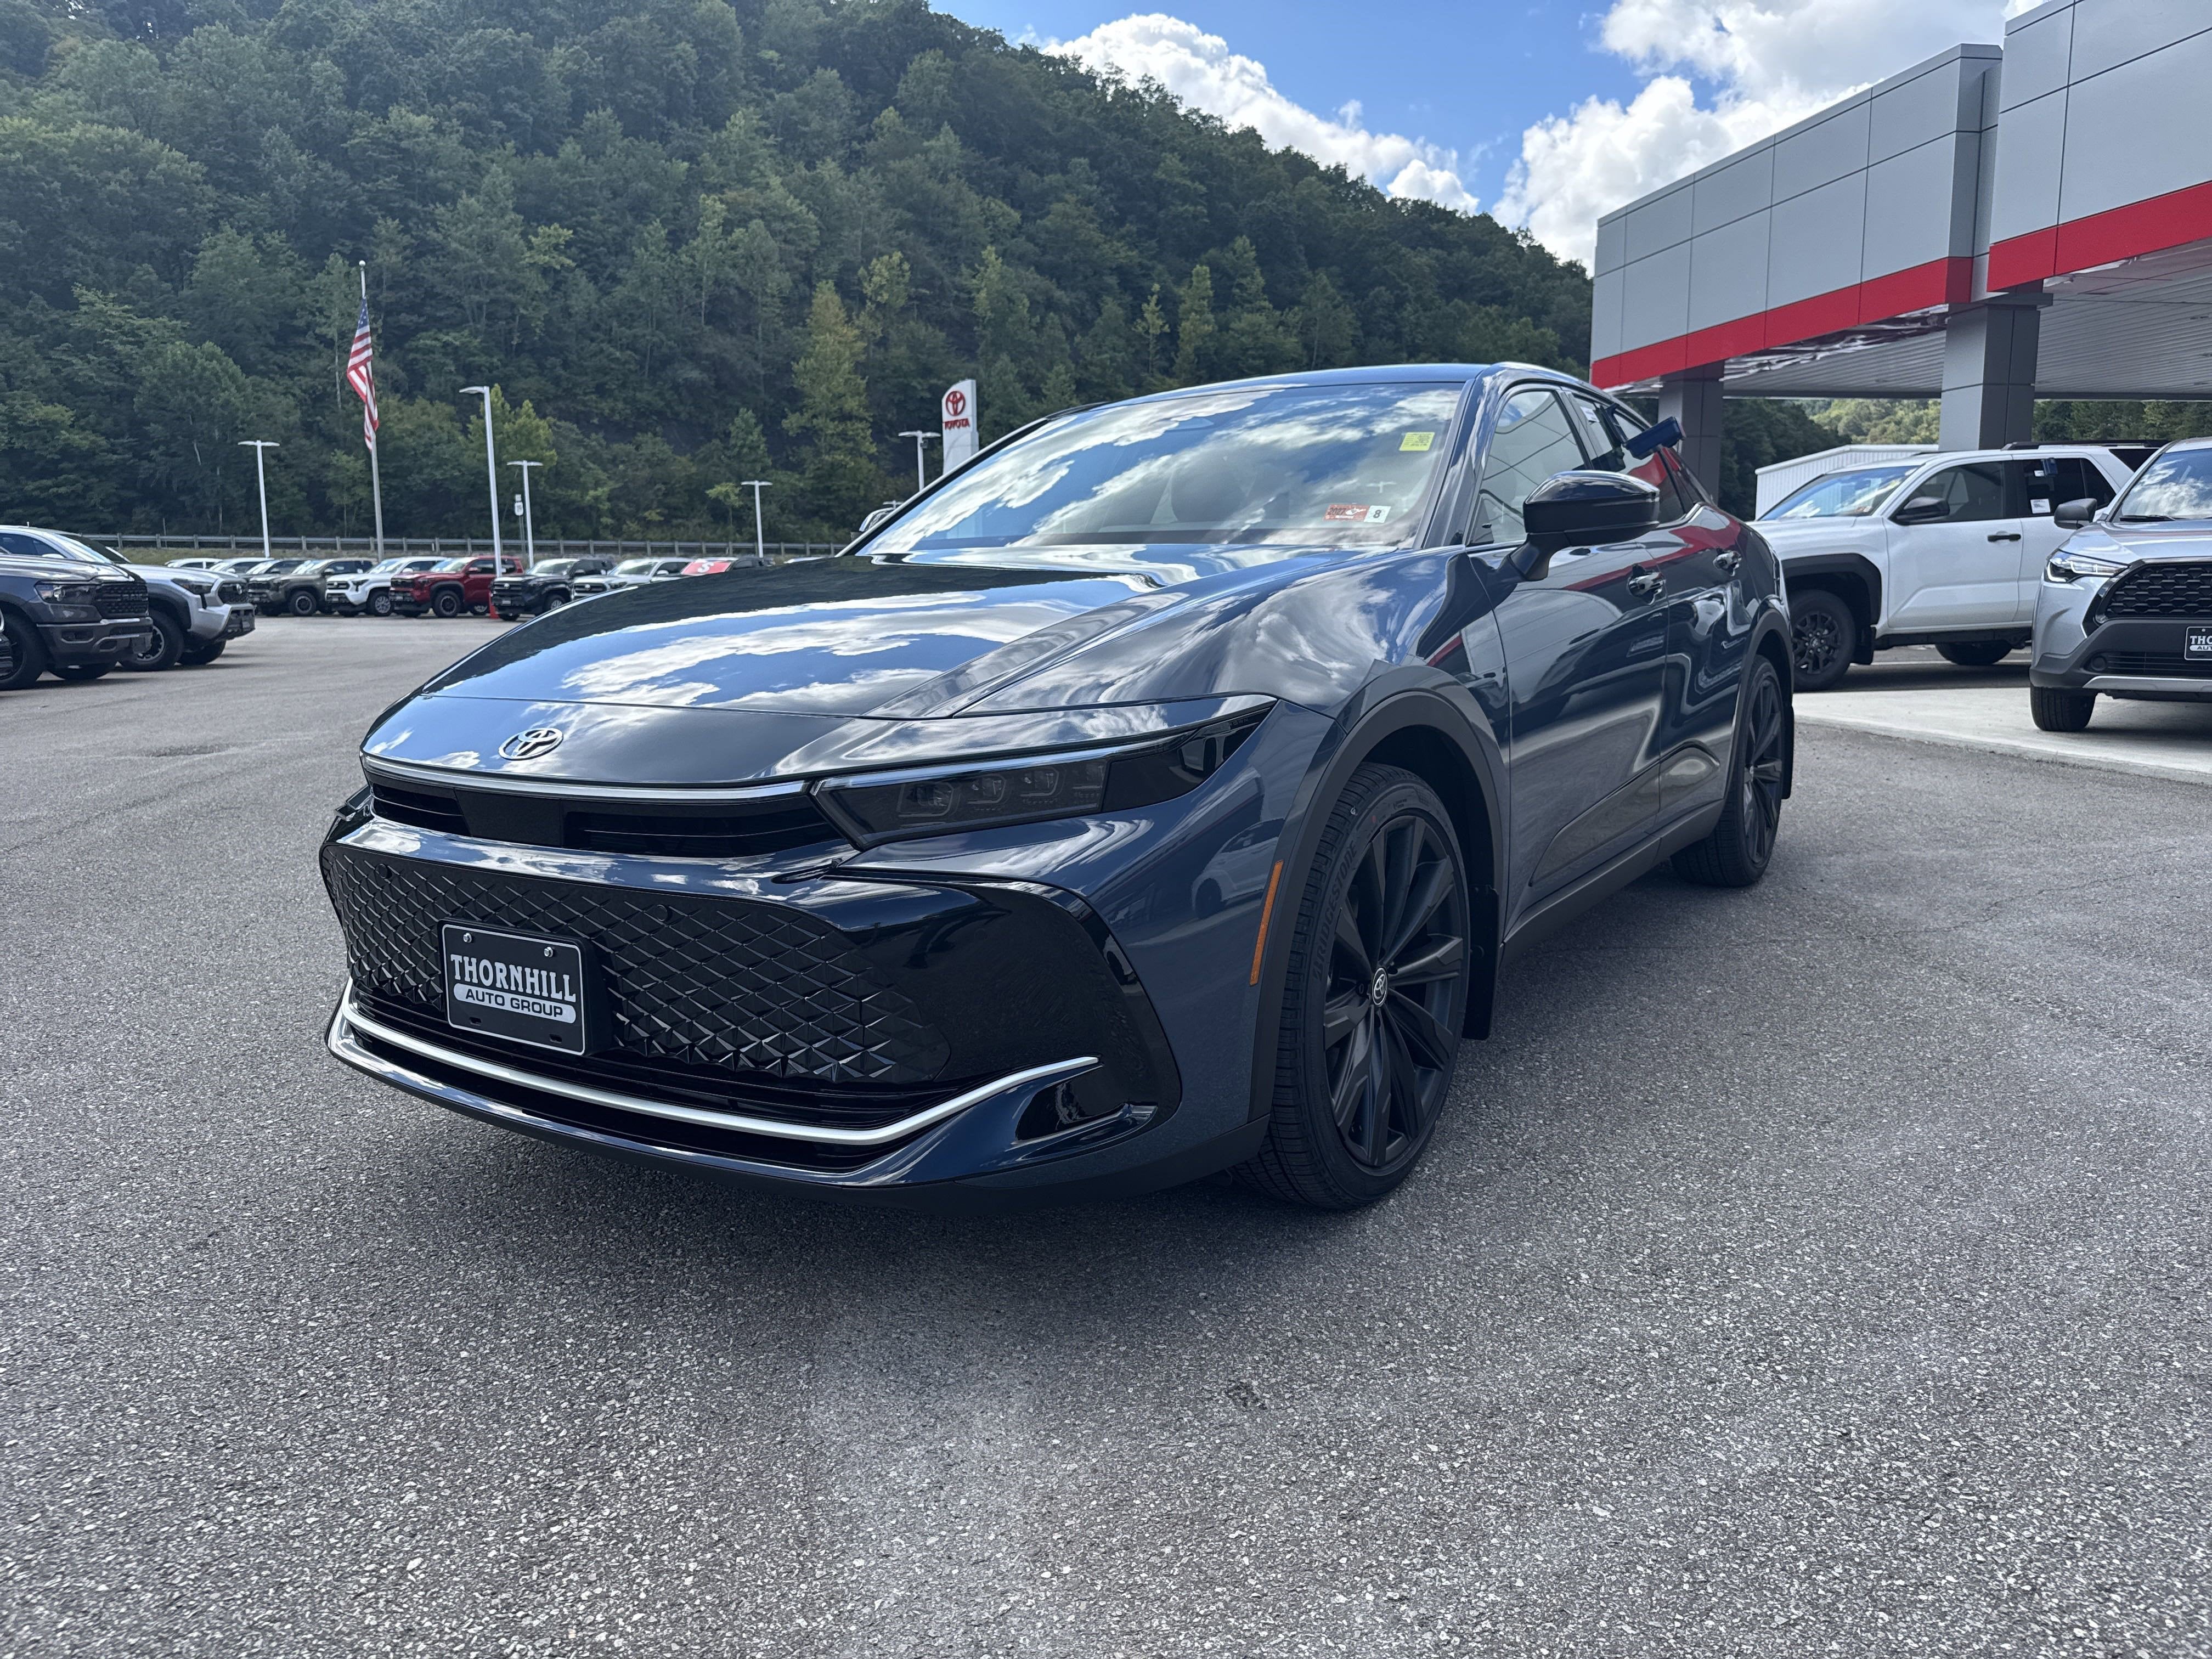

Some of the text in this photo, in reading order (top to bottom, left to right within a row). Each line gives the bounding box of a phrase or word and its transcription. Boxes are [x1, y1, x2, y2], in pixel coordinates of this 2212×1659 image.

[944, 418, 970, 430] TOYOTA
[1373, 509, 1382, 518] 8
[1312, 840, 1357, 981] BRIDGESTONE
[450, 954, 576, 1002] THORNHILL
[465, 989, 563, 1018] AUTO GROUP
